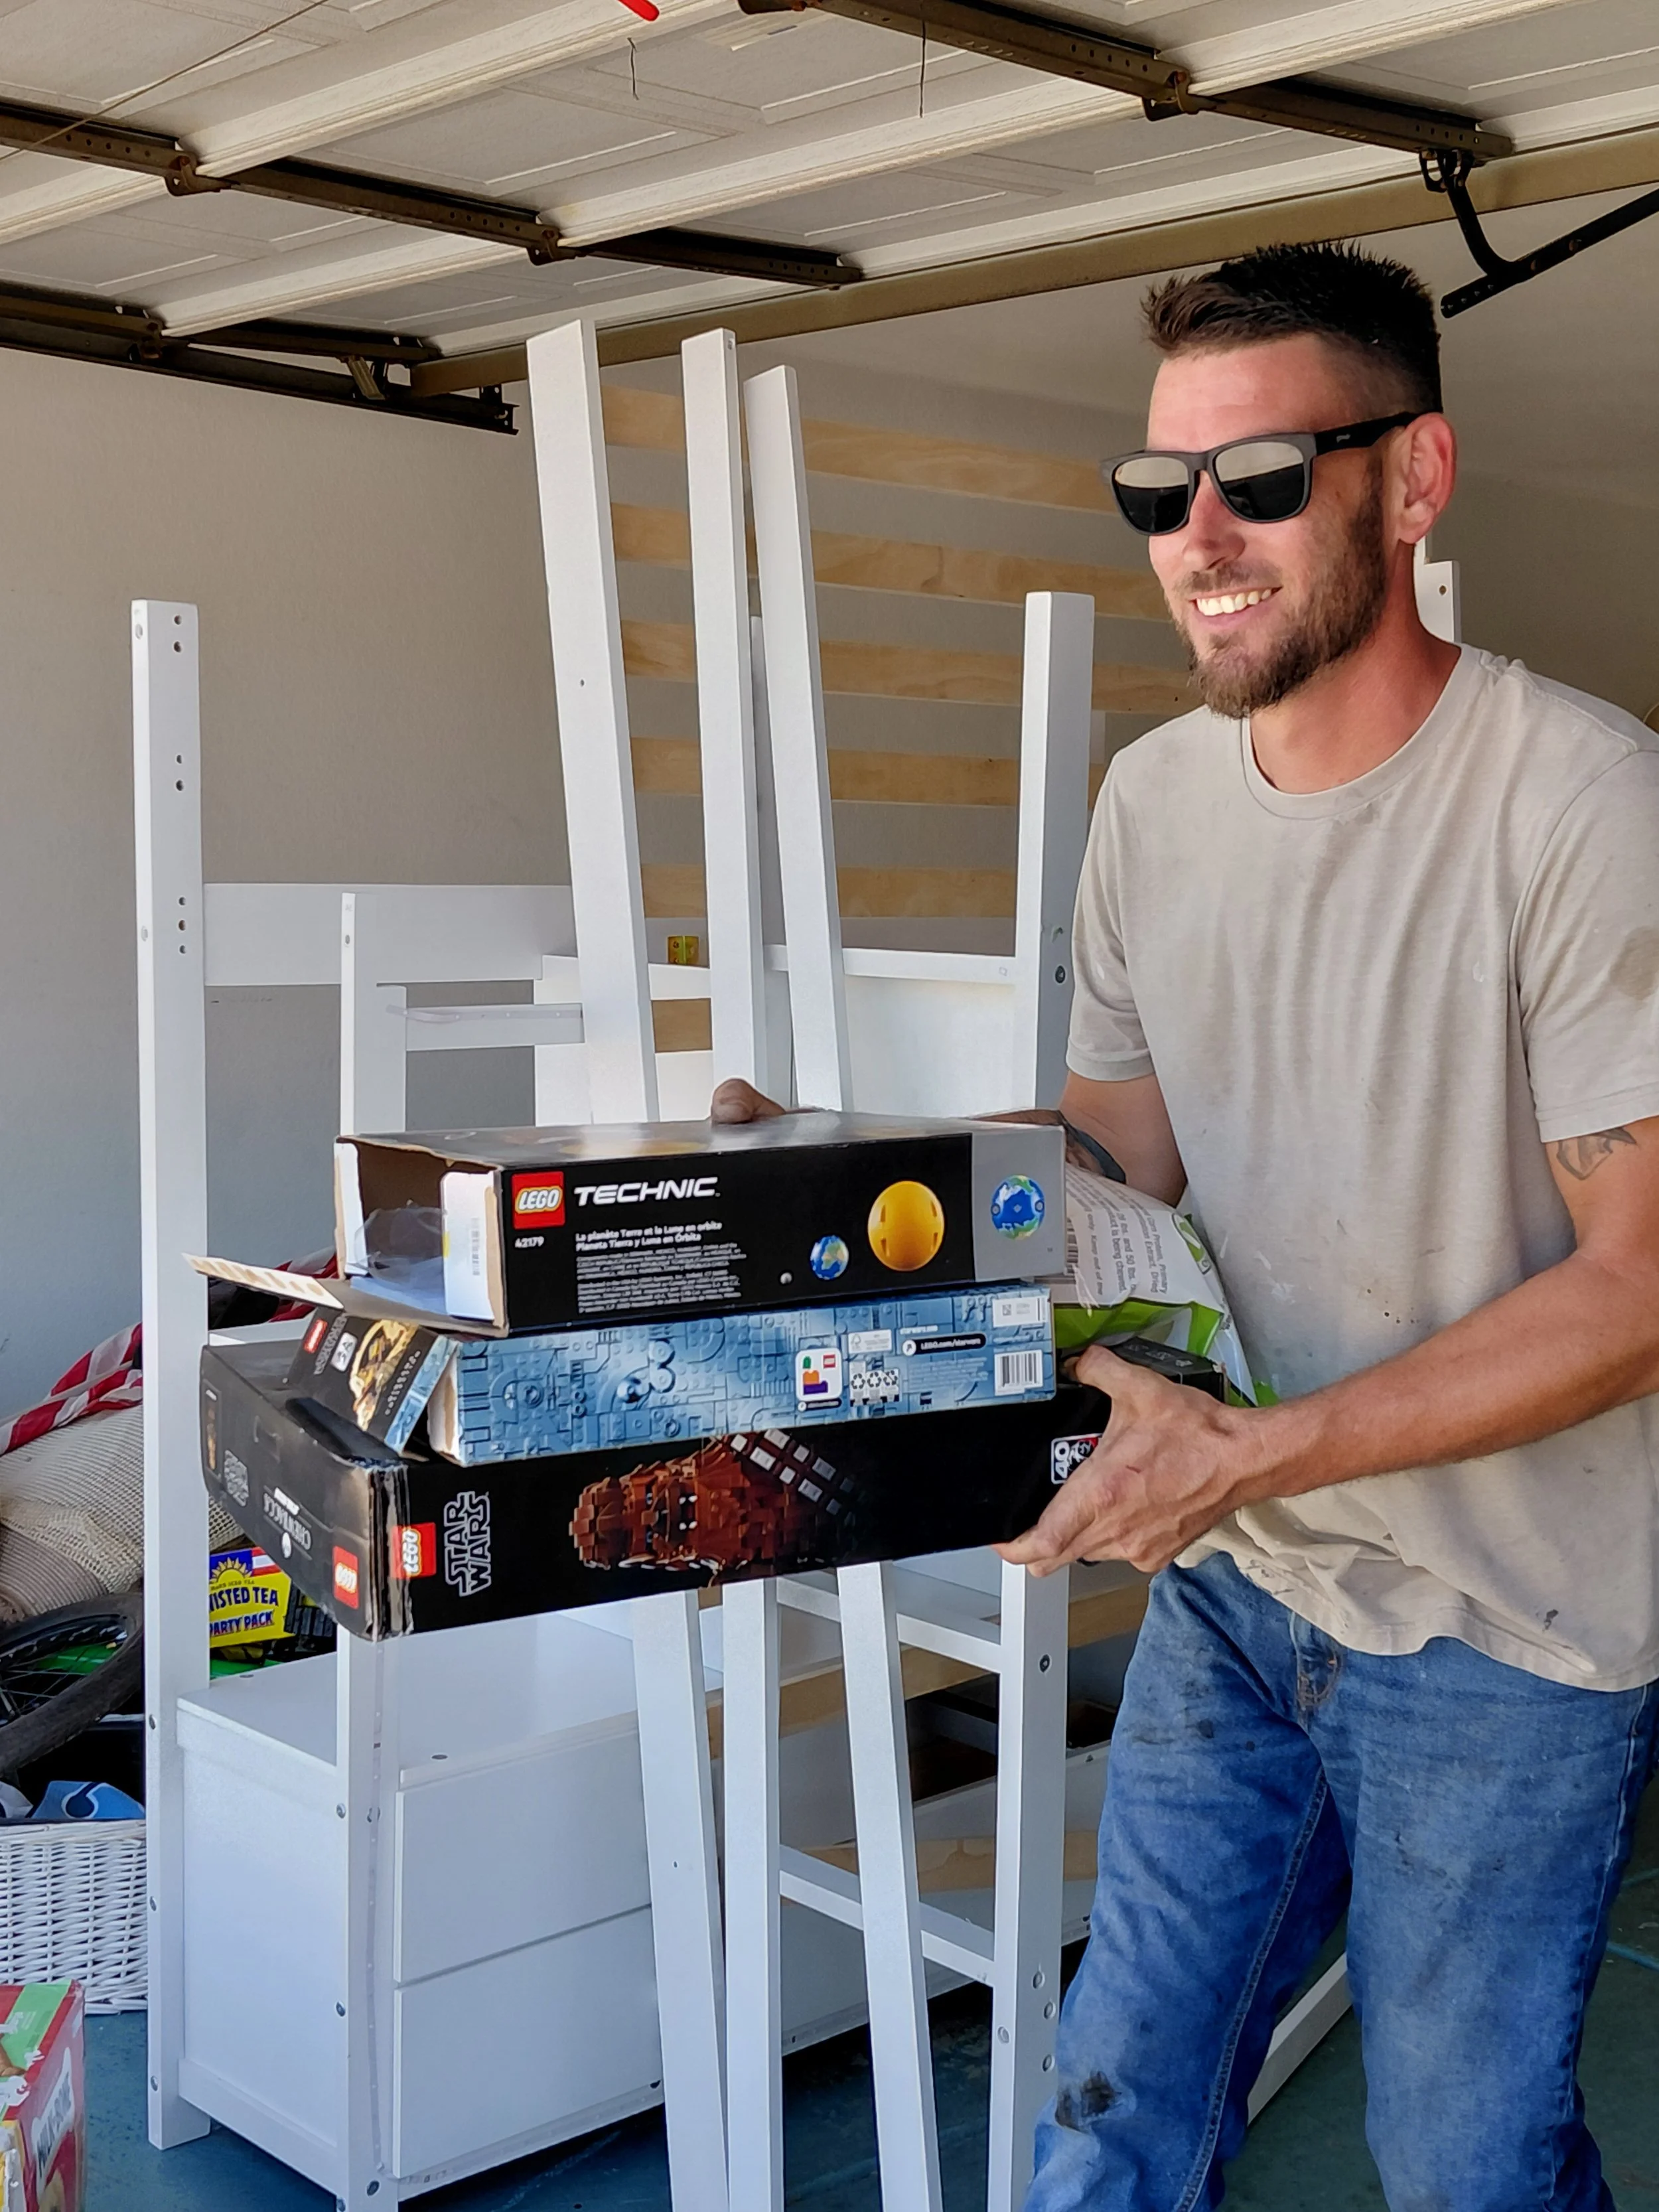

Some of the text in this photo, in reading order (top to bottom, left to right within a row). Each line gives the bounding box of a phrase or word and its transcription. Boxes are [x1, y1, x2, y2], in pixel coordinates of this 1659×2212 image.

[516, 1177, 718, 1213] LEGO TECHNIC
[1112, 1238, 1121, 1260] being
[1123, 1238, 1133, 1252] and
[402, 1527, 422, 1578] LEGO
[444, 1492, 469, 1597] STAR
[467, 1492, 492, 1594] WARS
[253, 1587, 279, 1607] TEA
[243, 1609, 275, 1631] PACK
